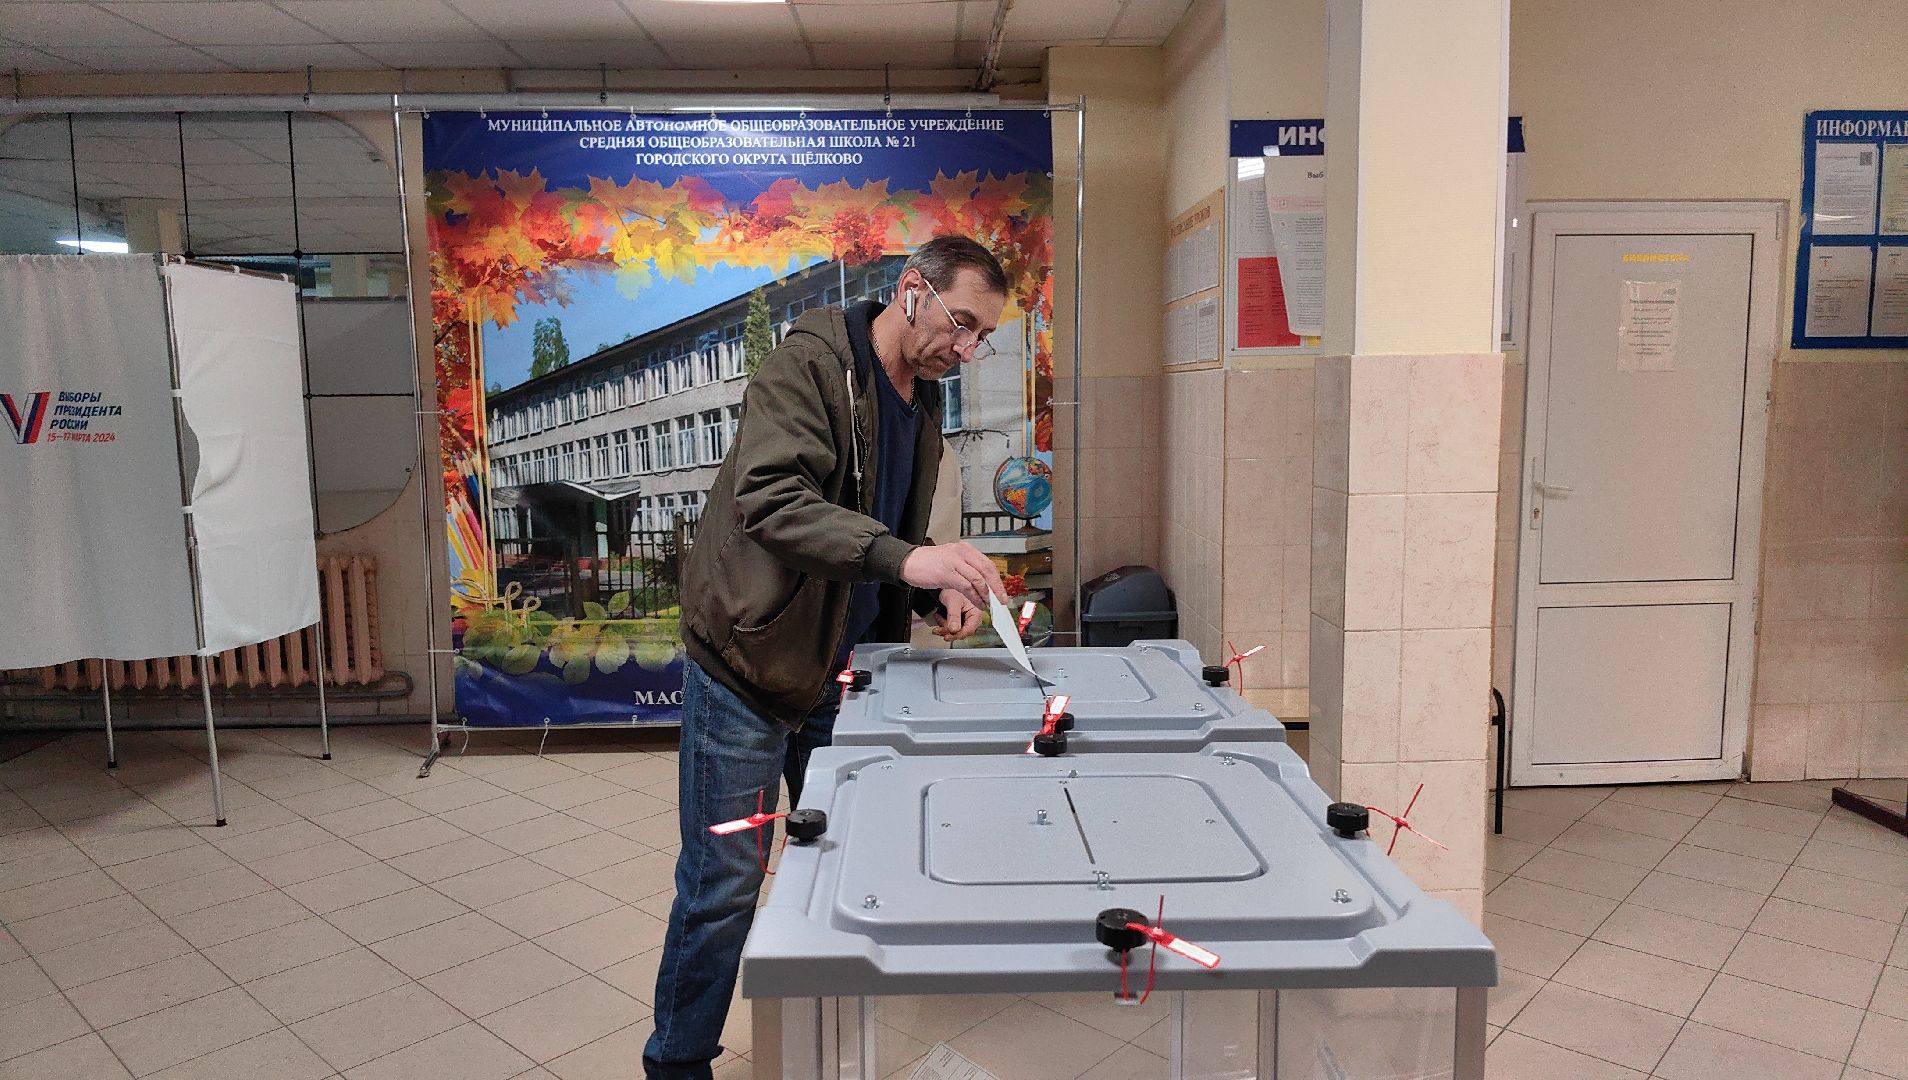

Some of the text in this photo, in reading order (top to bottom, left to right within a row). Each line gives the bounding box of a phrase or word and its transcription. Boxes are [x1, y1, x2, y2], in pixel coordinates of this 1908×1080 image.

[488, 119, 1005, 133] МУНИЦИПАЛЬНОЕ АВТОНОМНОЕ ОБЩЕОБРАЗОВАТЕЛЬНОЕ УЧРЕЖДЕНИЕ
[580, 136, 916, 150] СРЕДНЯЯ ОБЩЕОБРАЗОВАТЕЛЬНАЯ ШКОЛА № 21
[635, 151, 863, 166] ГОРОДСКОГО ОКРУГА ЩЁЛКОВО
[58, 391, 102, 402] ВЫБОРЫ
[54, 405, 122, 418] ПРЕЗИДЕНТА
[50, 419, 89, 430] РОССИИ
[93, 433, 116, 442] 2024
